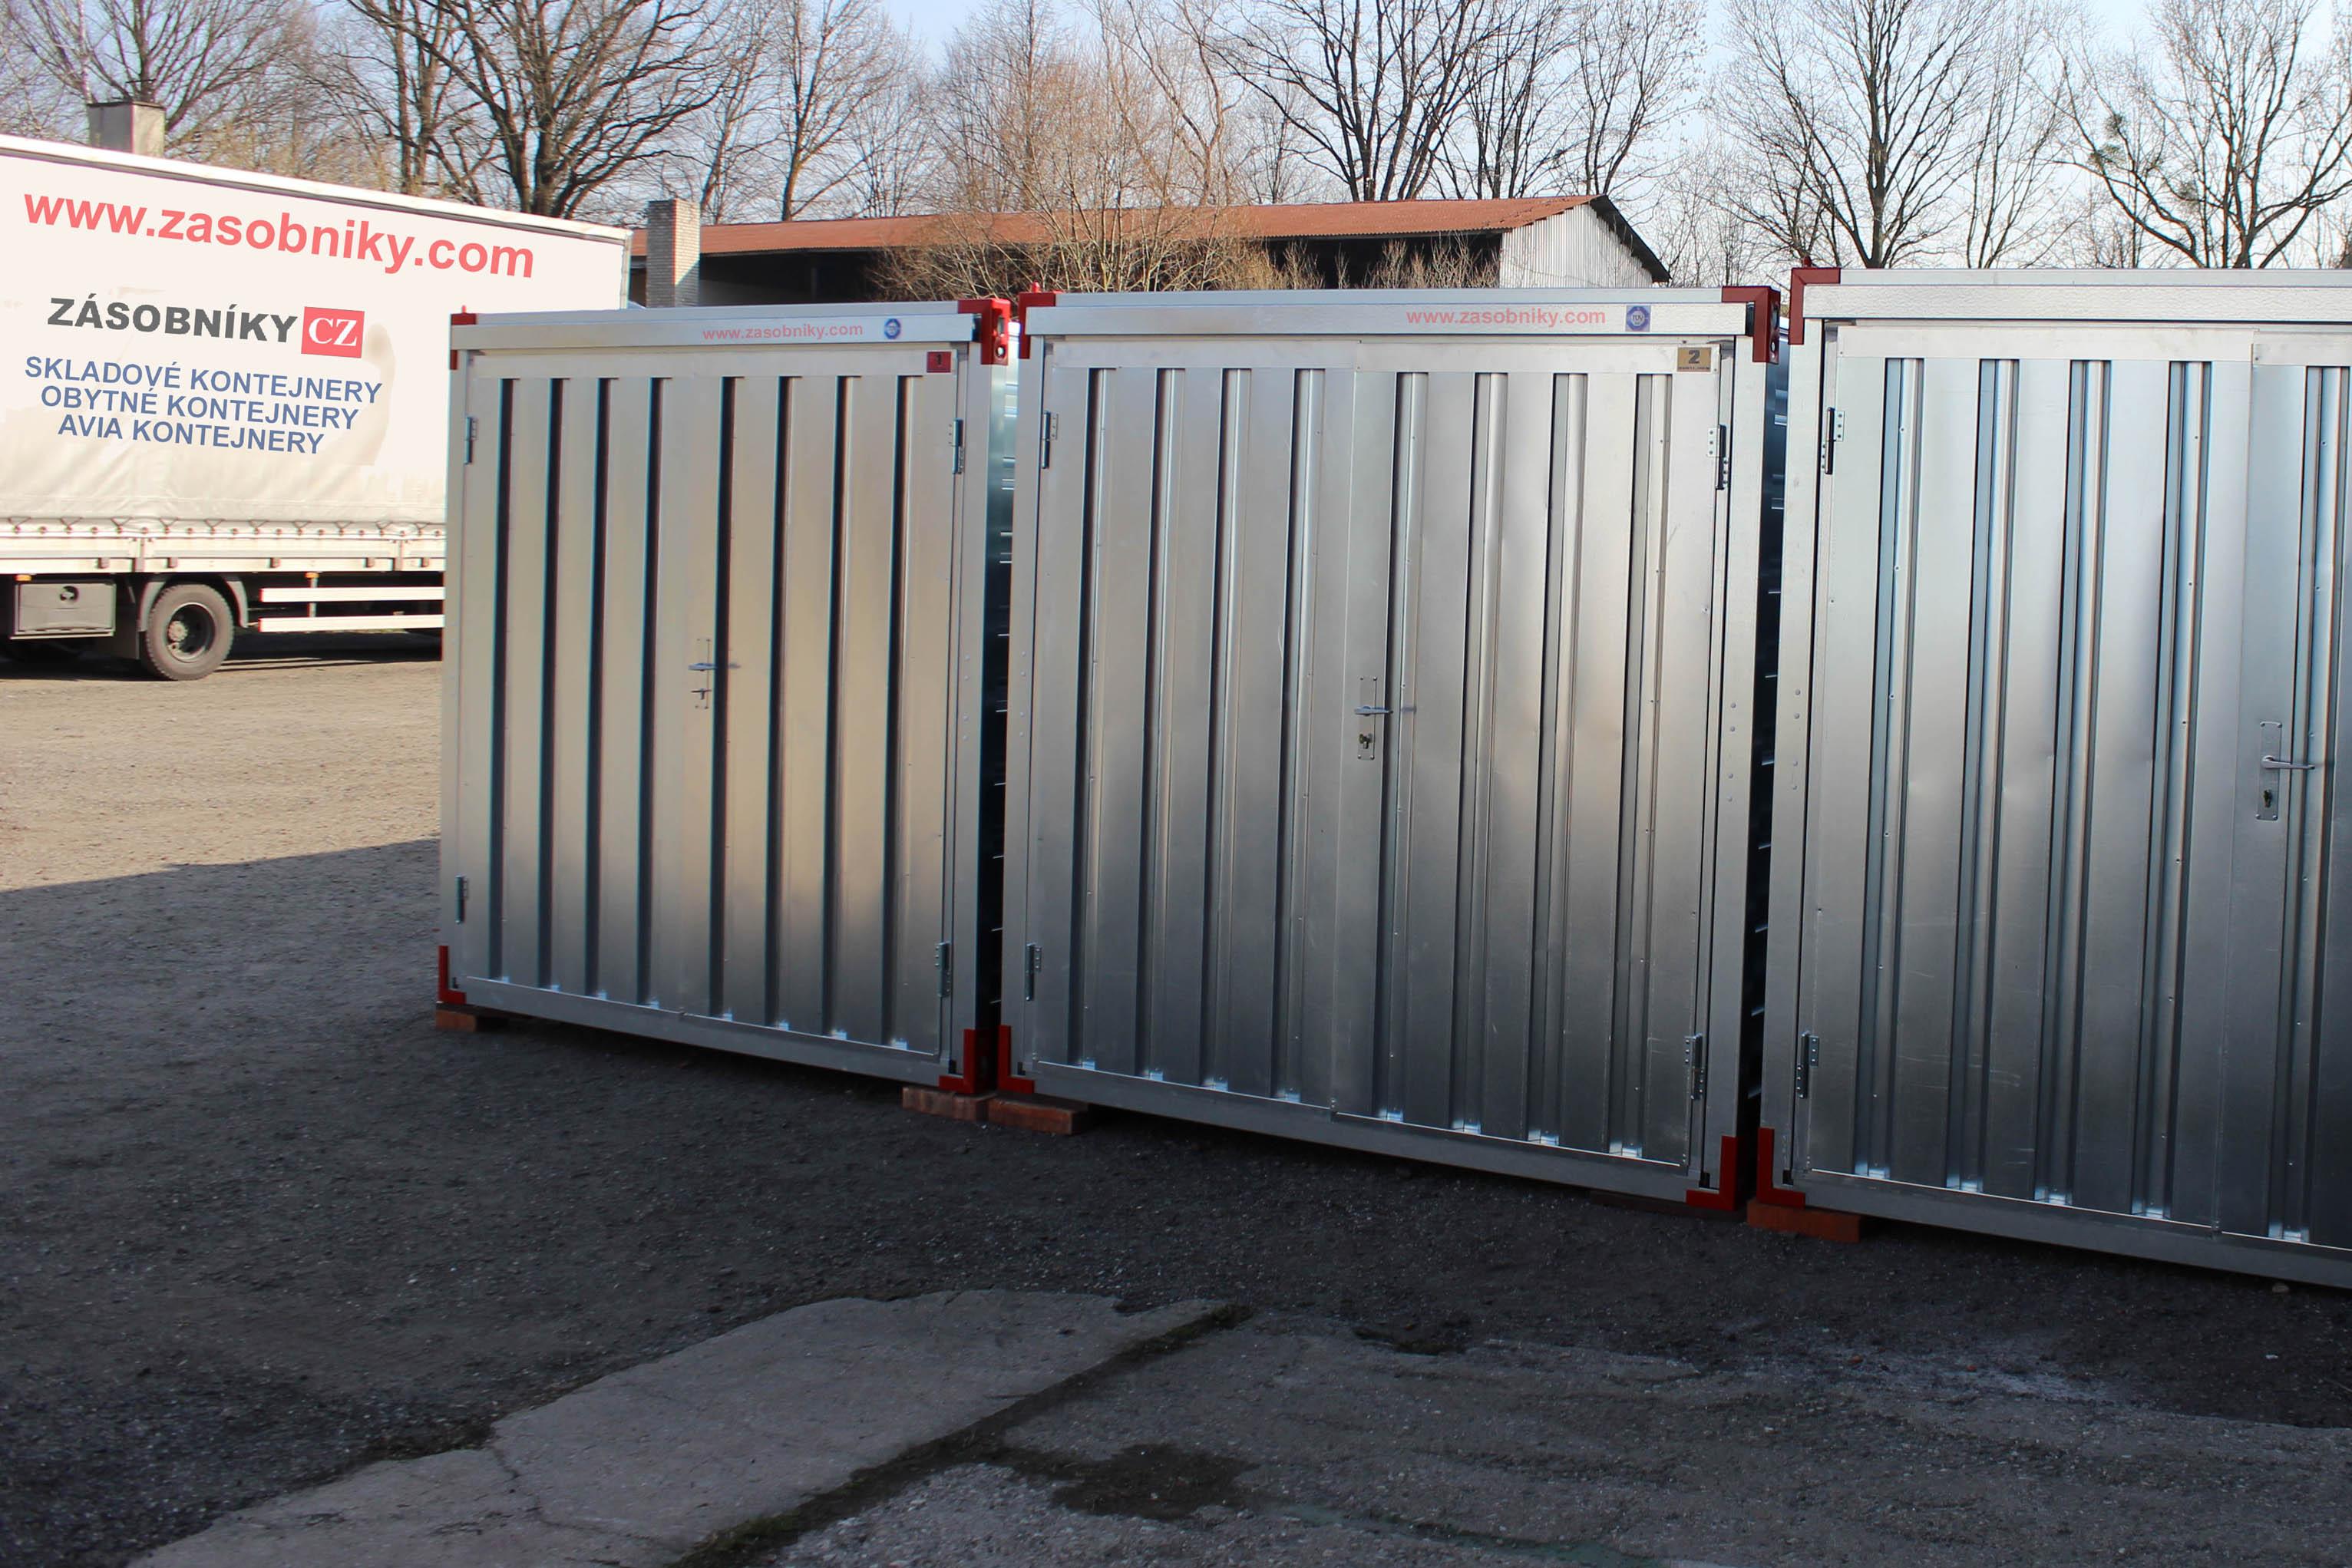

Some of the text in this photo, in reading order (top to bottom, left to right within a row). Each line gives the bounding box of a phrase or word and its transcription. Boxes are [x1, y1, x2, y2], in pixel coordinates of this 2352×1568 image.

[24, 193, 534, 278] www.zasobniky.com
[47, 293, 358, 347] ZÁSOBNÍKY CZ
[702, 323, 864, 341] www.zasobniky.com
[1406, 307, 1607, 328] www.zasobniky.com
[1688, 350, 1700, 364] 2
[25, 356, 383, 404] SKLADOVÉ KONTEJNERY
[41, 385, 359, 431] OBYTNÉ KONTEJNERY
[58, 414, 325, 454] AVIA KONTEJNERY
